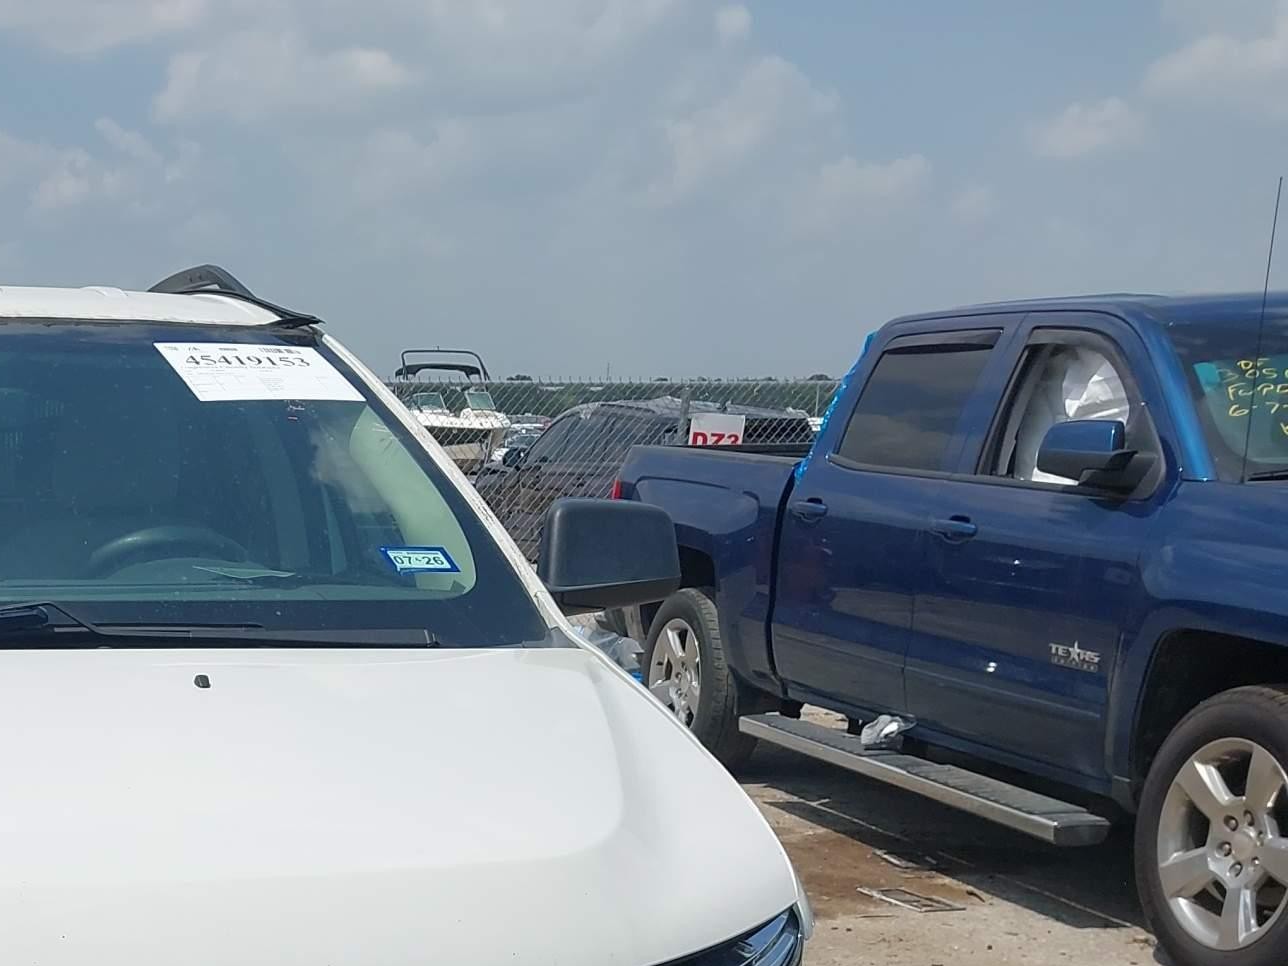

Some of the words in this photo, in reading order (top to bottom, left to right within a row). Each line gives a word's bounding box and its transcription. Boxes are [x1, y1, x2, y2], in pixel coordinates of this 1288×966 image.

[186, 354, 311, 367] 45419153
[393, 555, 413, 565] 07
[422, 556, 445, 566] 26
[1048, 641, 1101, 663] TEXAS
